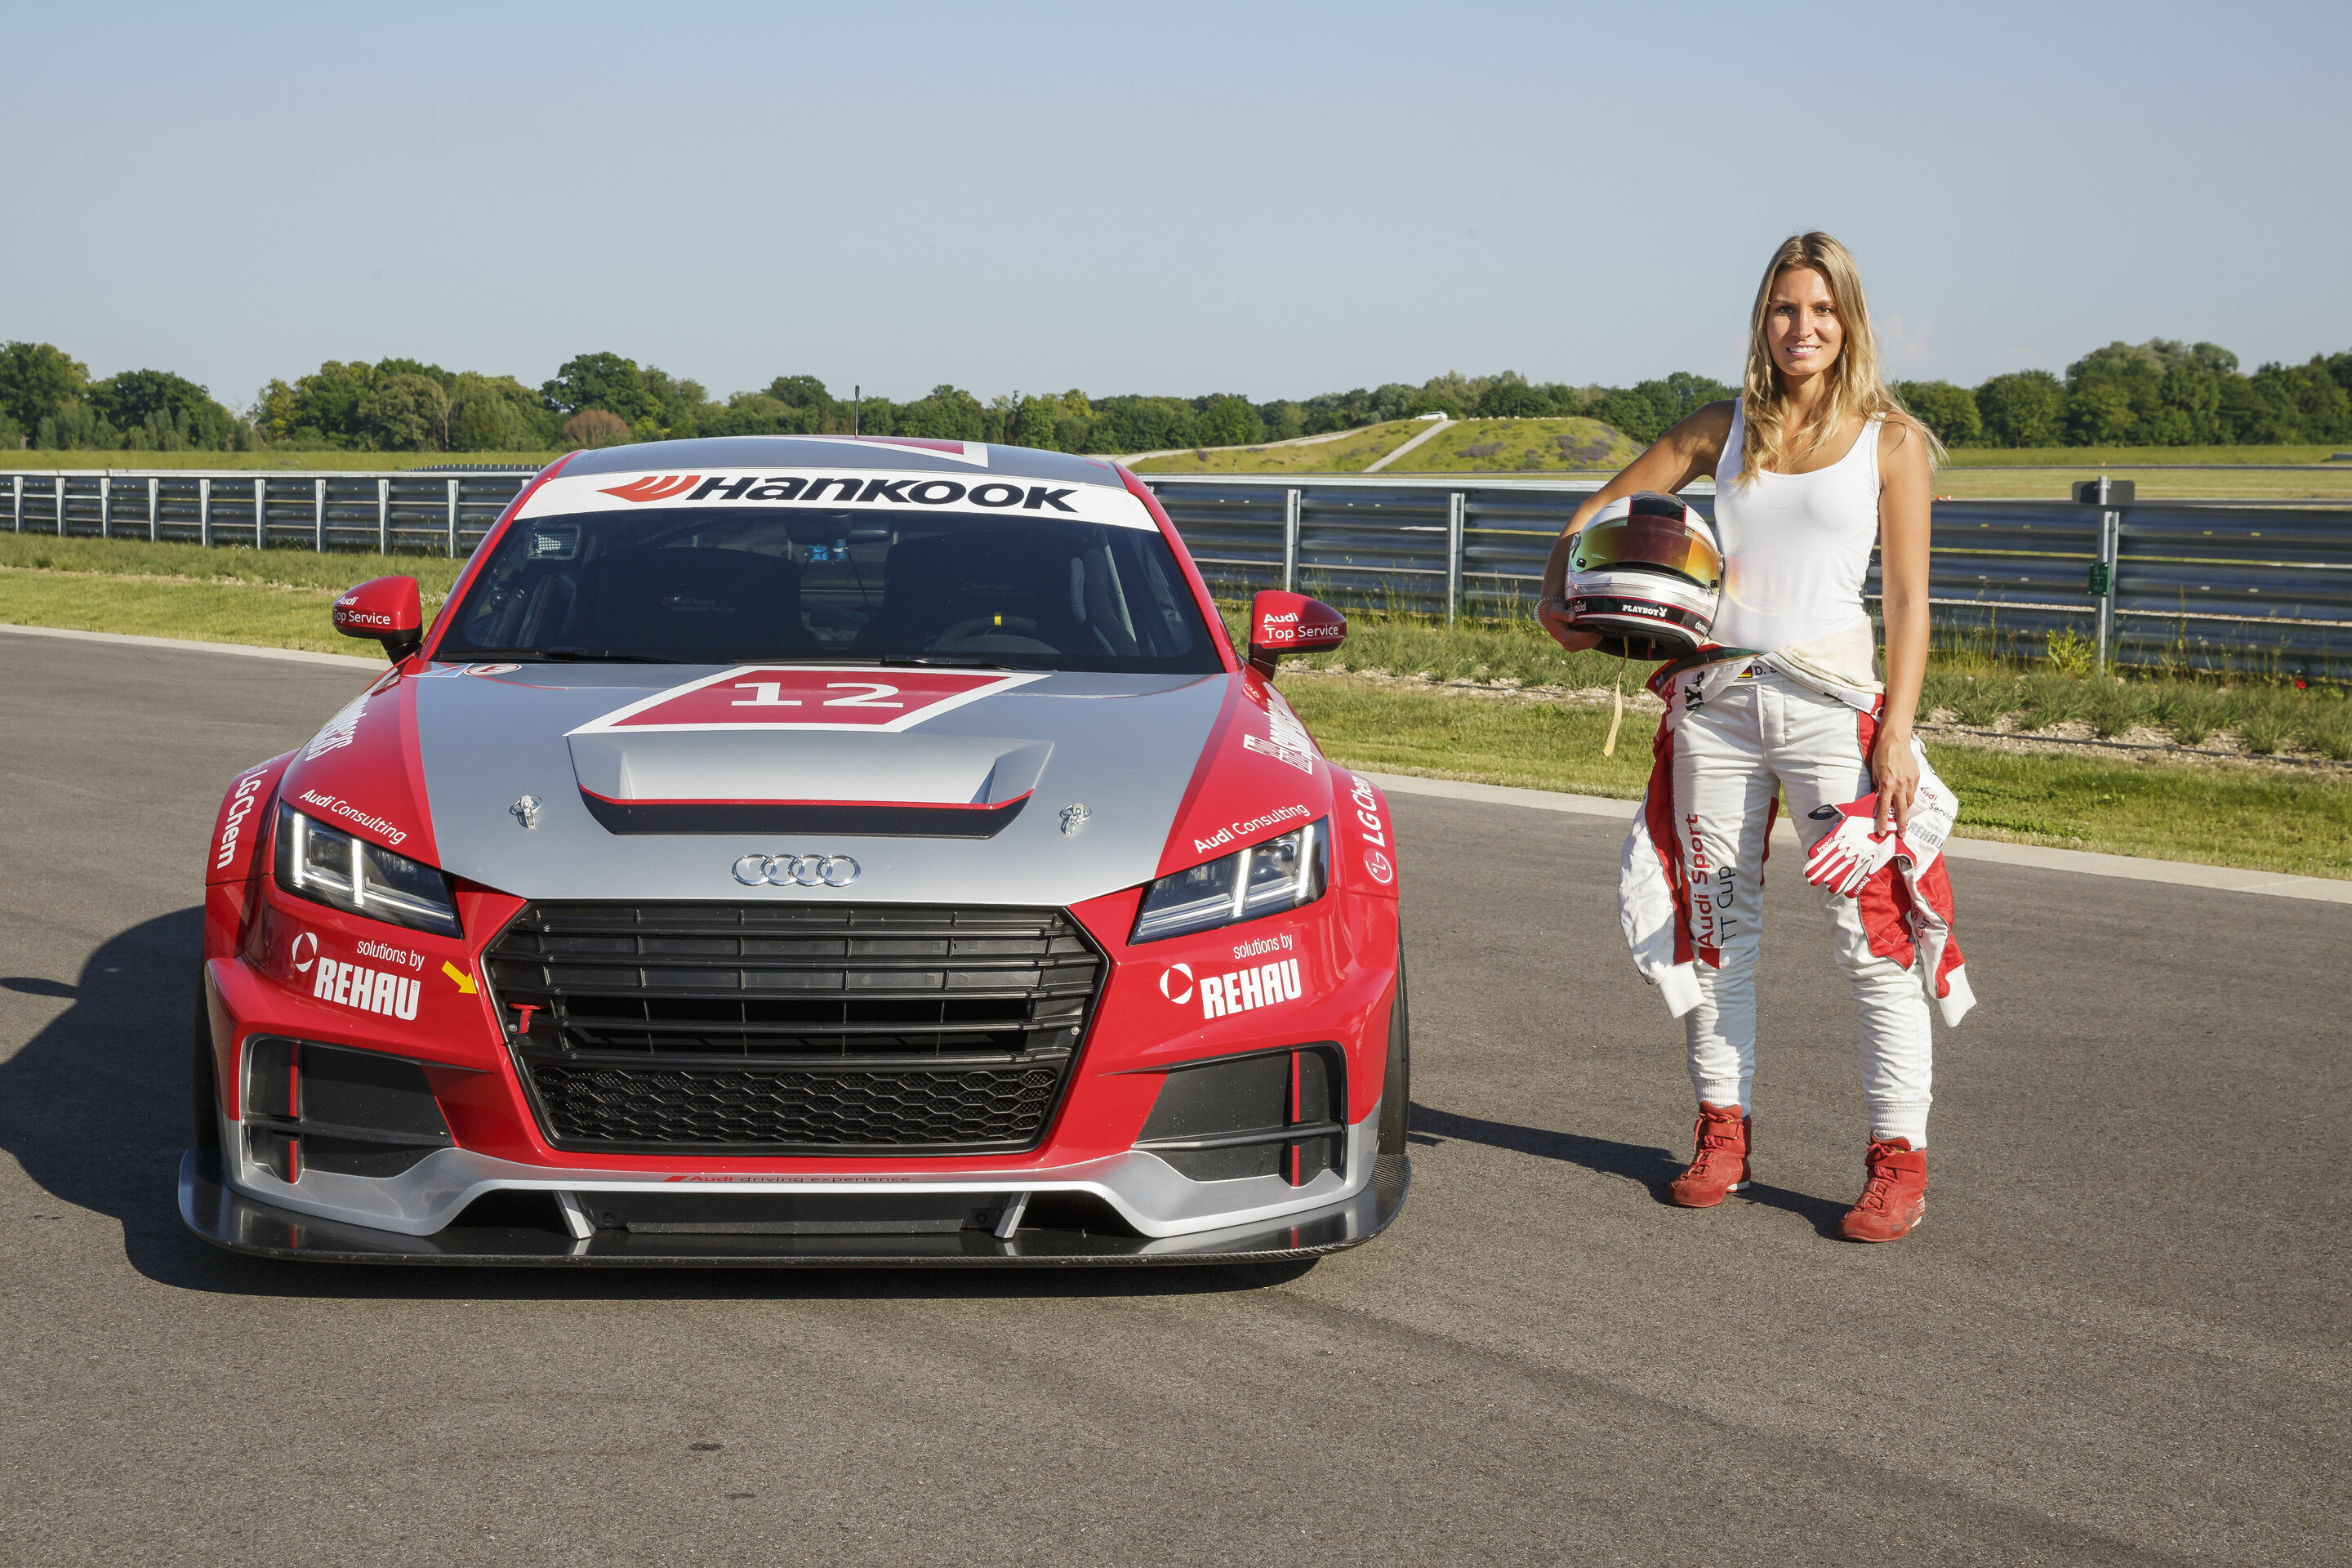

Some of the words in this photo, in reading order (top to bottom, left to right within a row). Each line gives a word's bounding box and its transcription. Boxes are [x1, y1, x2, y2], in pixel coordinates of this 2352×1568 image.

[336, 595, 359, 605] Audi
[1622, 604, 1659, 617] PLAYBOY
[333, 608, 347, 624] Top
[348, 610, 391, 626] Service
[1263, 612, 1299, 624] Audi
[1264, 627, 1294, 641] Top
[1298, 624, 1339, 638] Service
[731, 682, 904, 709] 12
[234, 768, 269, 800] LG
[216, 795, 255, 870] Chem
[299, 789, 336, 808] Audi
[331, 800, 408, 845] Consulting
[1193, 827, 1236, 854] Audi
[1232, 804, 1311, 835] Consulting
[1356, 809, 1386, 848] LG
[1685, 813, 1711, 885] Sport
[1717, 866, 1736, 909] Cup
[1694, 893, 1714, 948] Audi
[1720, 915, 1738, 947] TT
[356, 940, 407, 964] solutions
[408, 949, 425, 972] by
[1233, 938, 1280, 960] solutions
[1279, 933, 1293, 951] by
[313, 956, 421, 1021] REHAU
[1200, 958, 1302, 1020] REHAU
